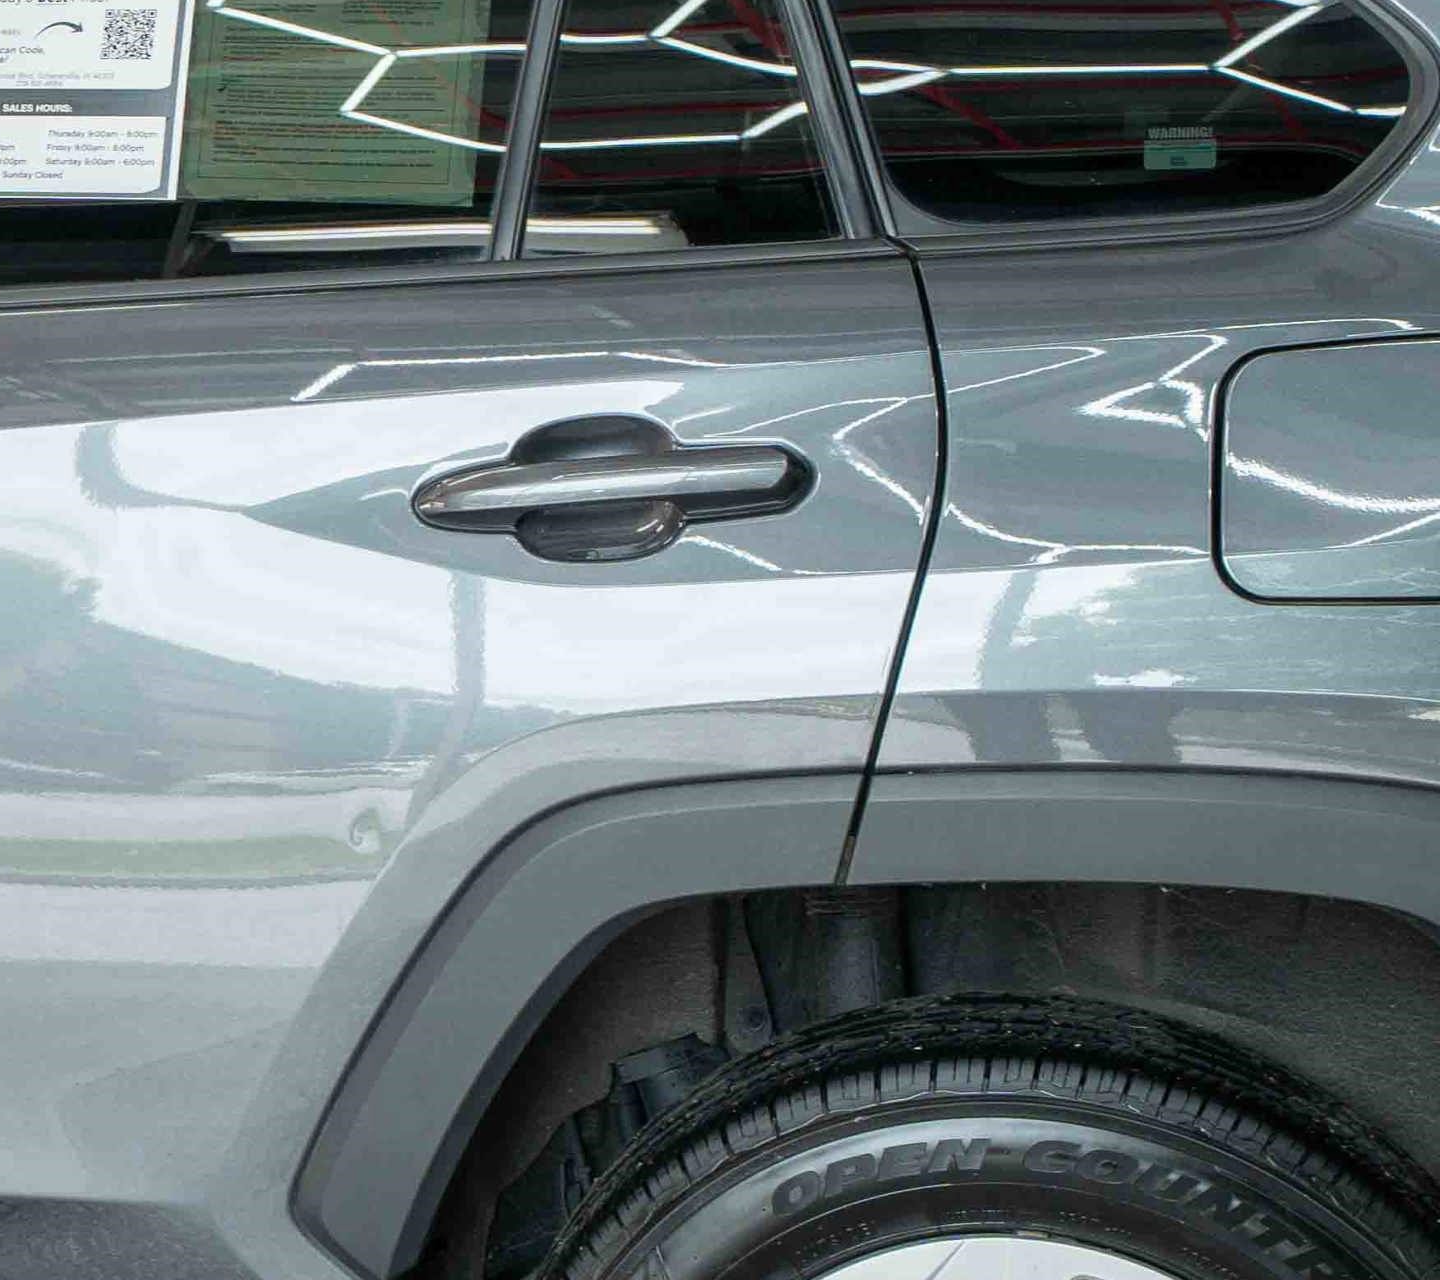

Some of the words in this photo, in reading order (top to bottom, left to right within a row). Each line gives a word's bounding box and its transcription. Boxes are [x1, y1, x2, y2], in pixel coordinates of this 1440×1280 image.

[2, 104, 34, 113] SALES
[36, 104, 72, 113] HOURS:
[1147, 126, 1214, 139] WARNING!
[2, 171, 33, 180] Sunday
[34, 171, 63, 179] Closed
[772, 1138, 991, 1216] OPEN
